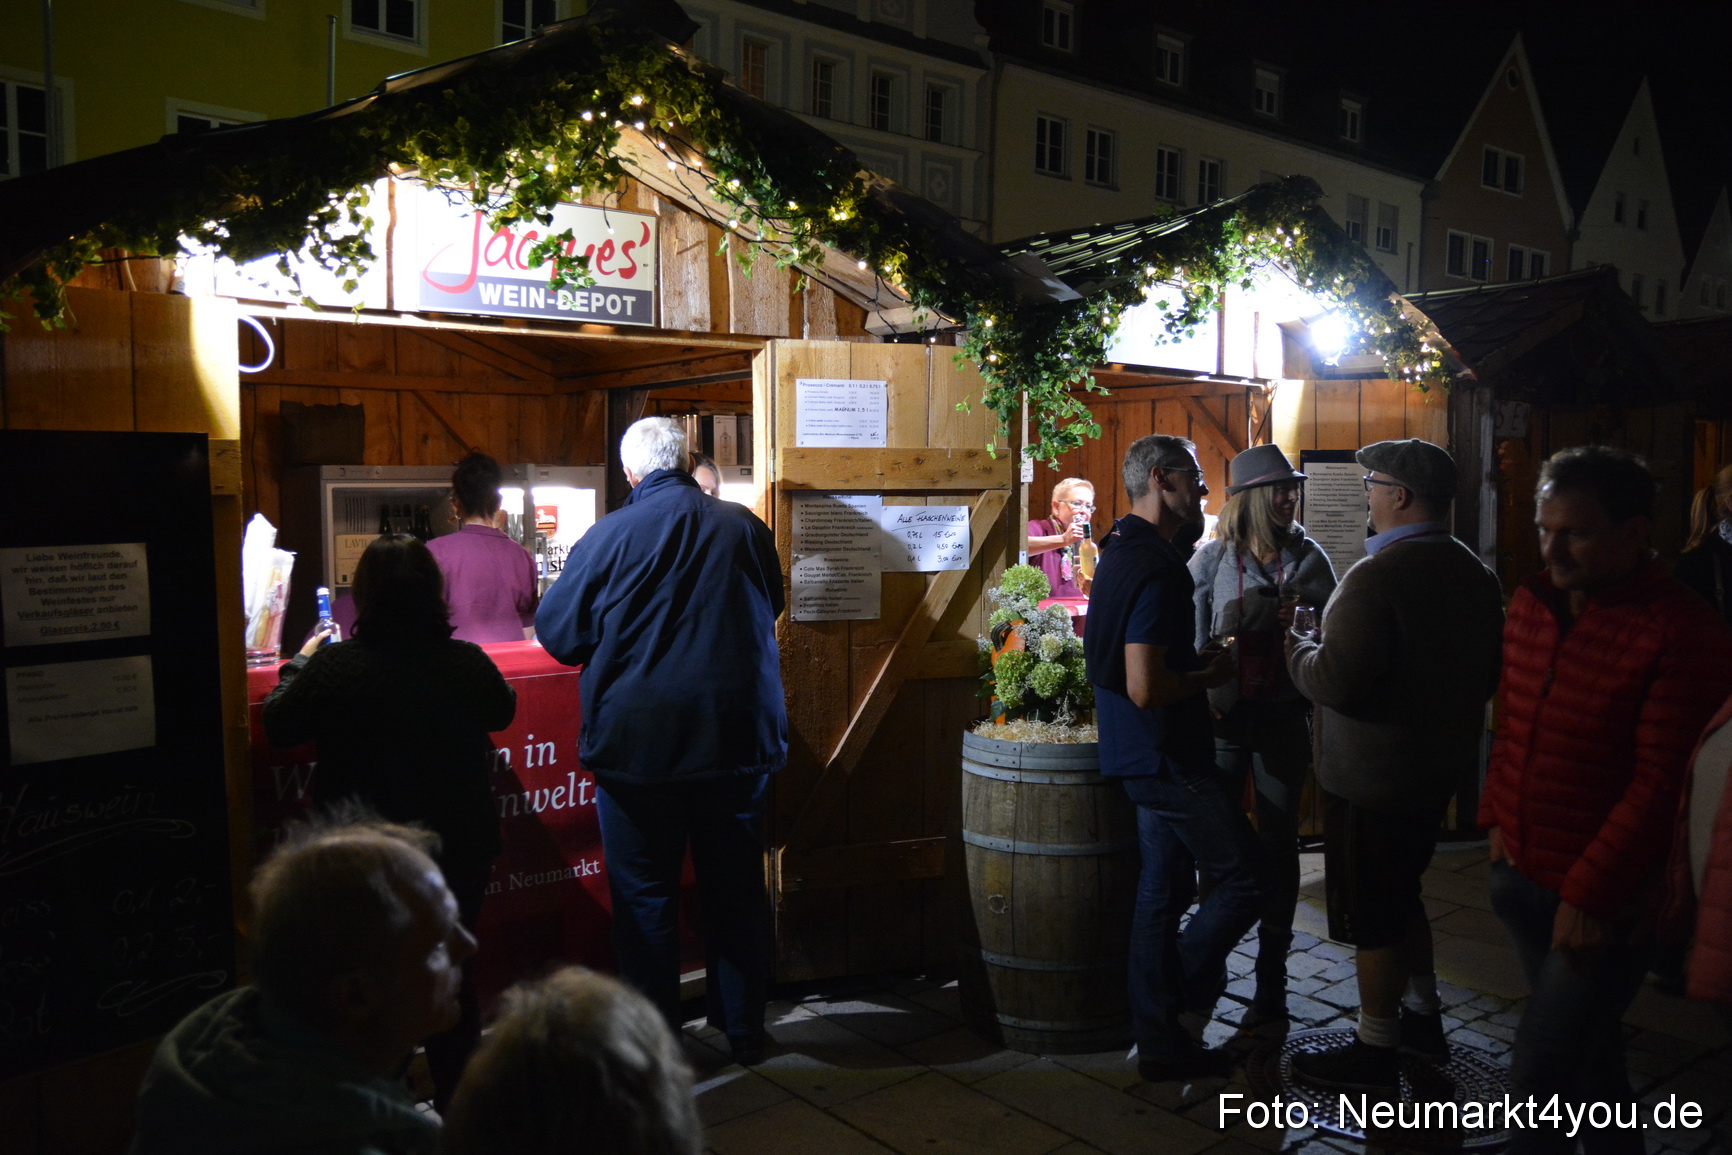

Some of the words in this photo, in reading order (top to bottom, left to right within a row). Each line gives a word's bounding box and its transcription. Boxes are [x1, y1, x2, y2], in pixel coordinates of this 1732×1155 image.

[478, 283, 637, 316] WEIN-DEPOT
[26, 553, 55, 562] Liebe
[30, 564, 67, 573] weisen
[70, 562, 105, 571] höflich
[107, 559, 138, 569] darauf
[48, 574, 68, 583] daß
[69, 573, 85, 582] wir
[88, 573, 106, 581] laut
[109, 572, 128, 580] den
[28, 584, 106, 596] Bestimmungen
[107, 583, 126, 591] des
[40, 596, 96, 606] Weinfestes
[17, 607, 95, 620] Verkaufsgläser
[97, 603, 138, 614] anbieten
[524, 733, 558, 769] in
[490, 771, 598, 818] nwelt.
[508, 859, 602, 891] Neumarkt
